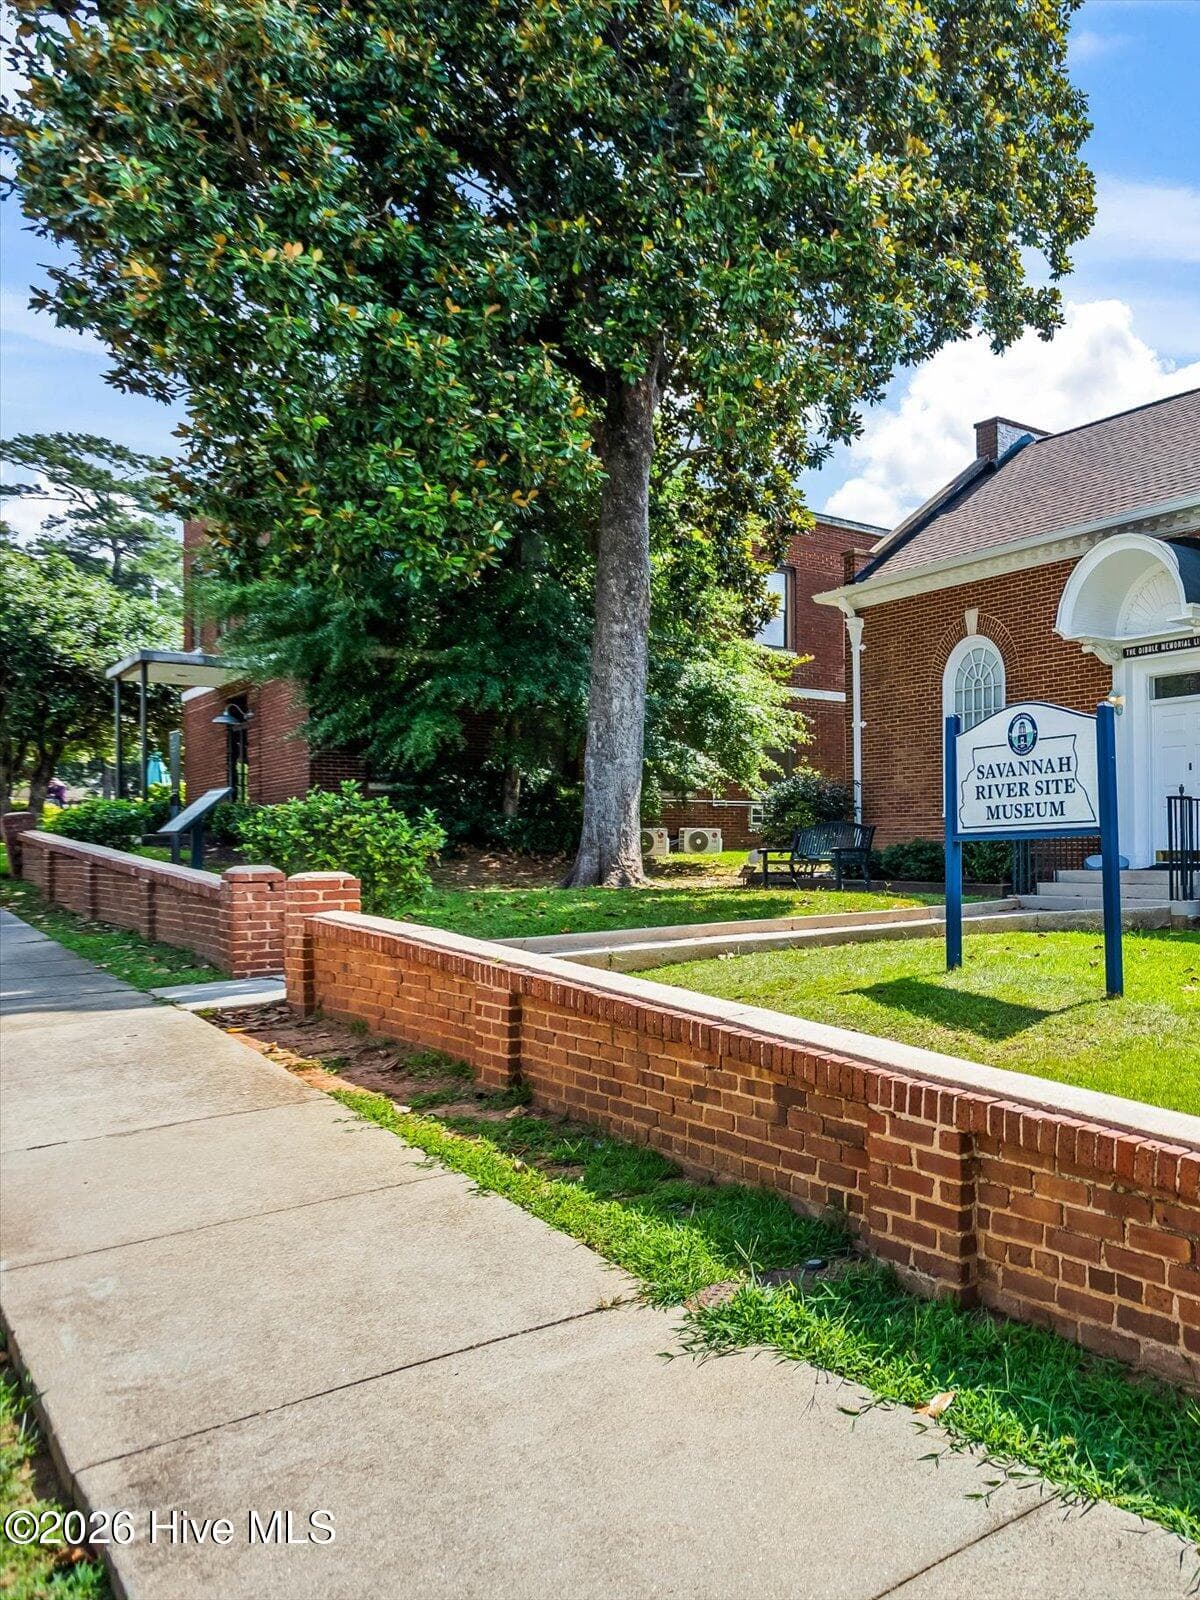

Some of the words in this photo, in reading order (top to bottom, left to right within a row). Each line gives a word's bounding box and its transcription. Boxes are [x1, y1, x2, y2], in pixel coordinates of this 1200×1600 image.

[1125, 648, 1137, 657] THE
[1160, 639, 1191, 651] MEMORIAL
[976, 756, 1073, 780] SAVANNAH
[974, 781, 1030, 800] RIVER
[1034, 777, 1076, 796] SITE
[985, 800, 1066, 821] MUSEUM
